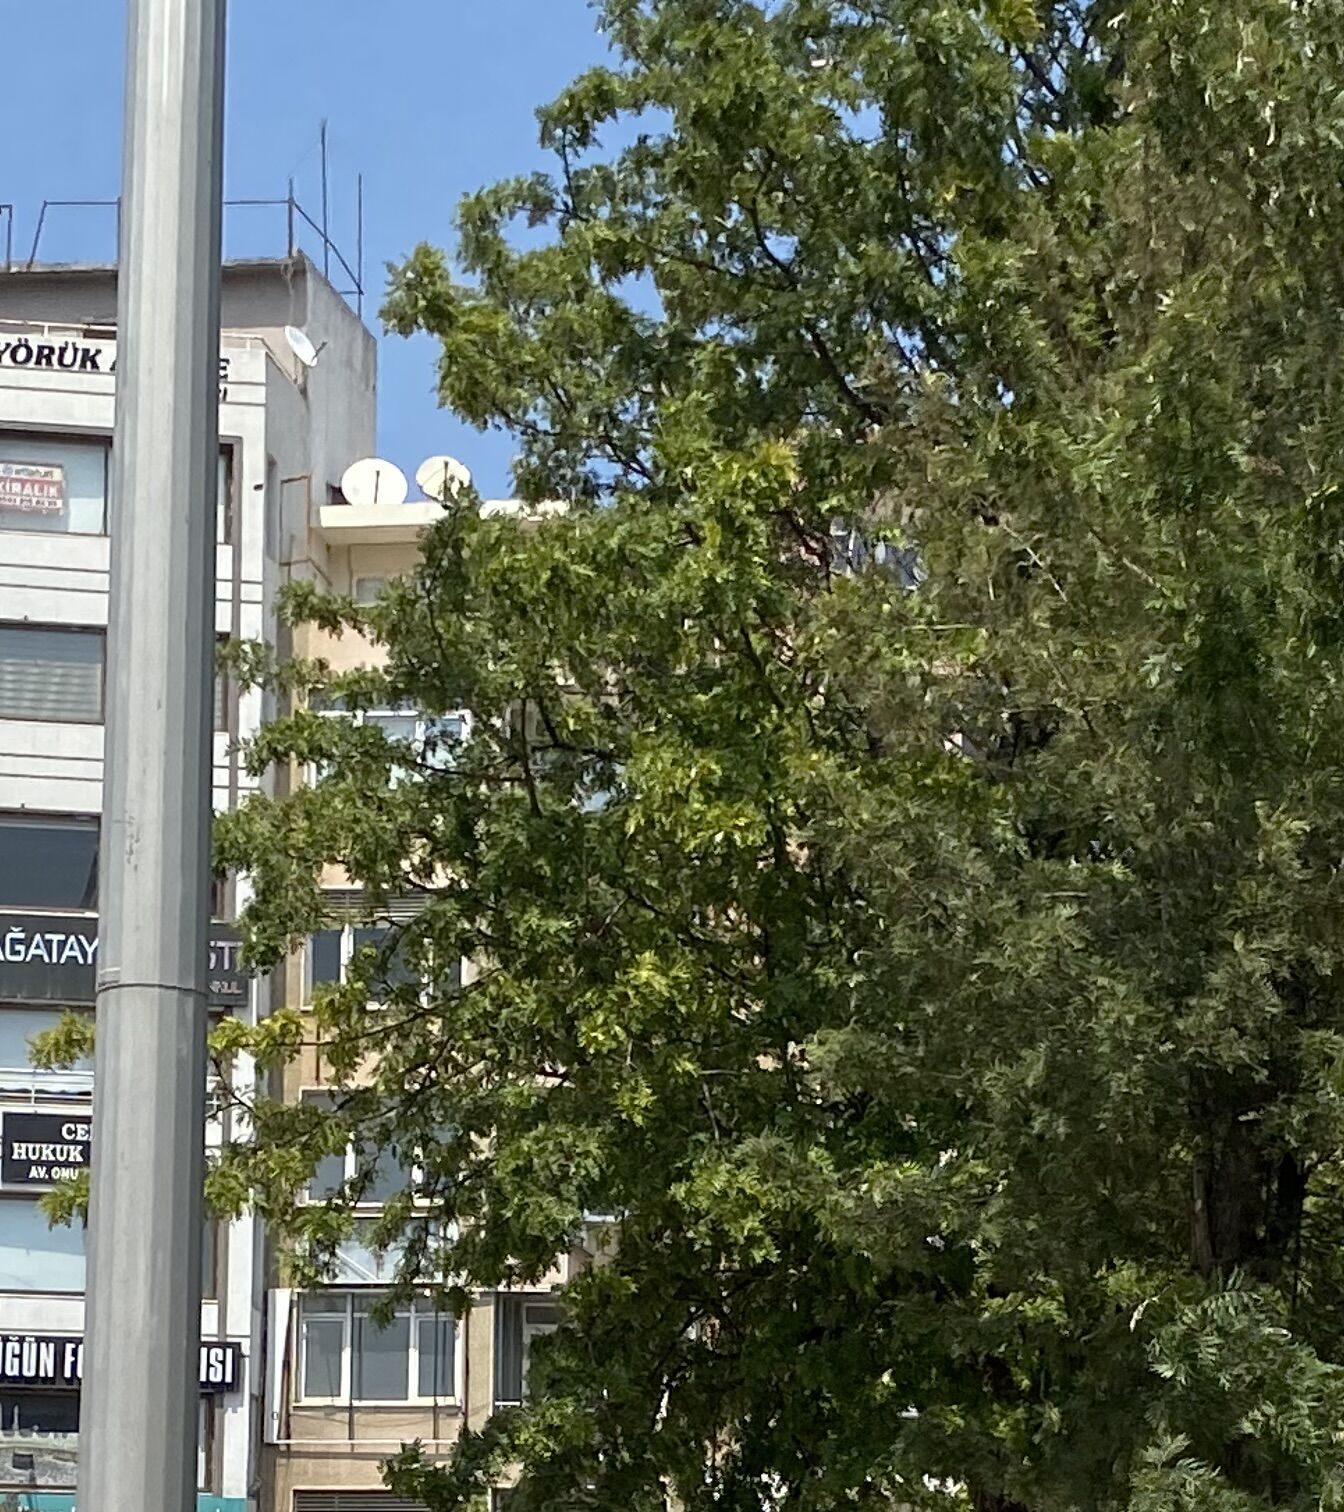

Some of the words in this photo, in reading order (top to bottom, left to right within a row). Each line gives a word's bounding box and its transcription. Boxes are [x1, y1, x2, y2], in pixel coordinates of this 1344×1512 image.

[61, 1123, 92, 1141] CE
[11, 1142, 83, 1162] HUKUK
[28, 1165, 49, 1180] AV.
